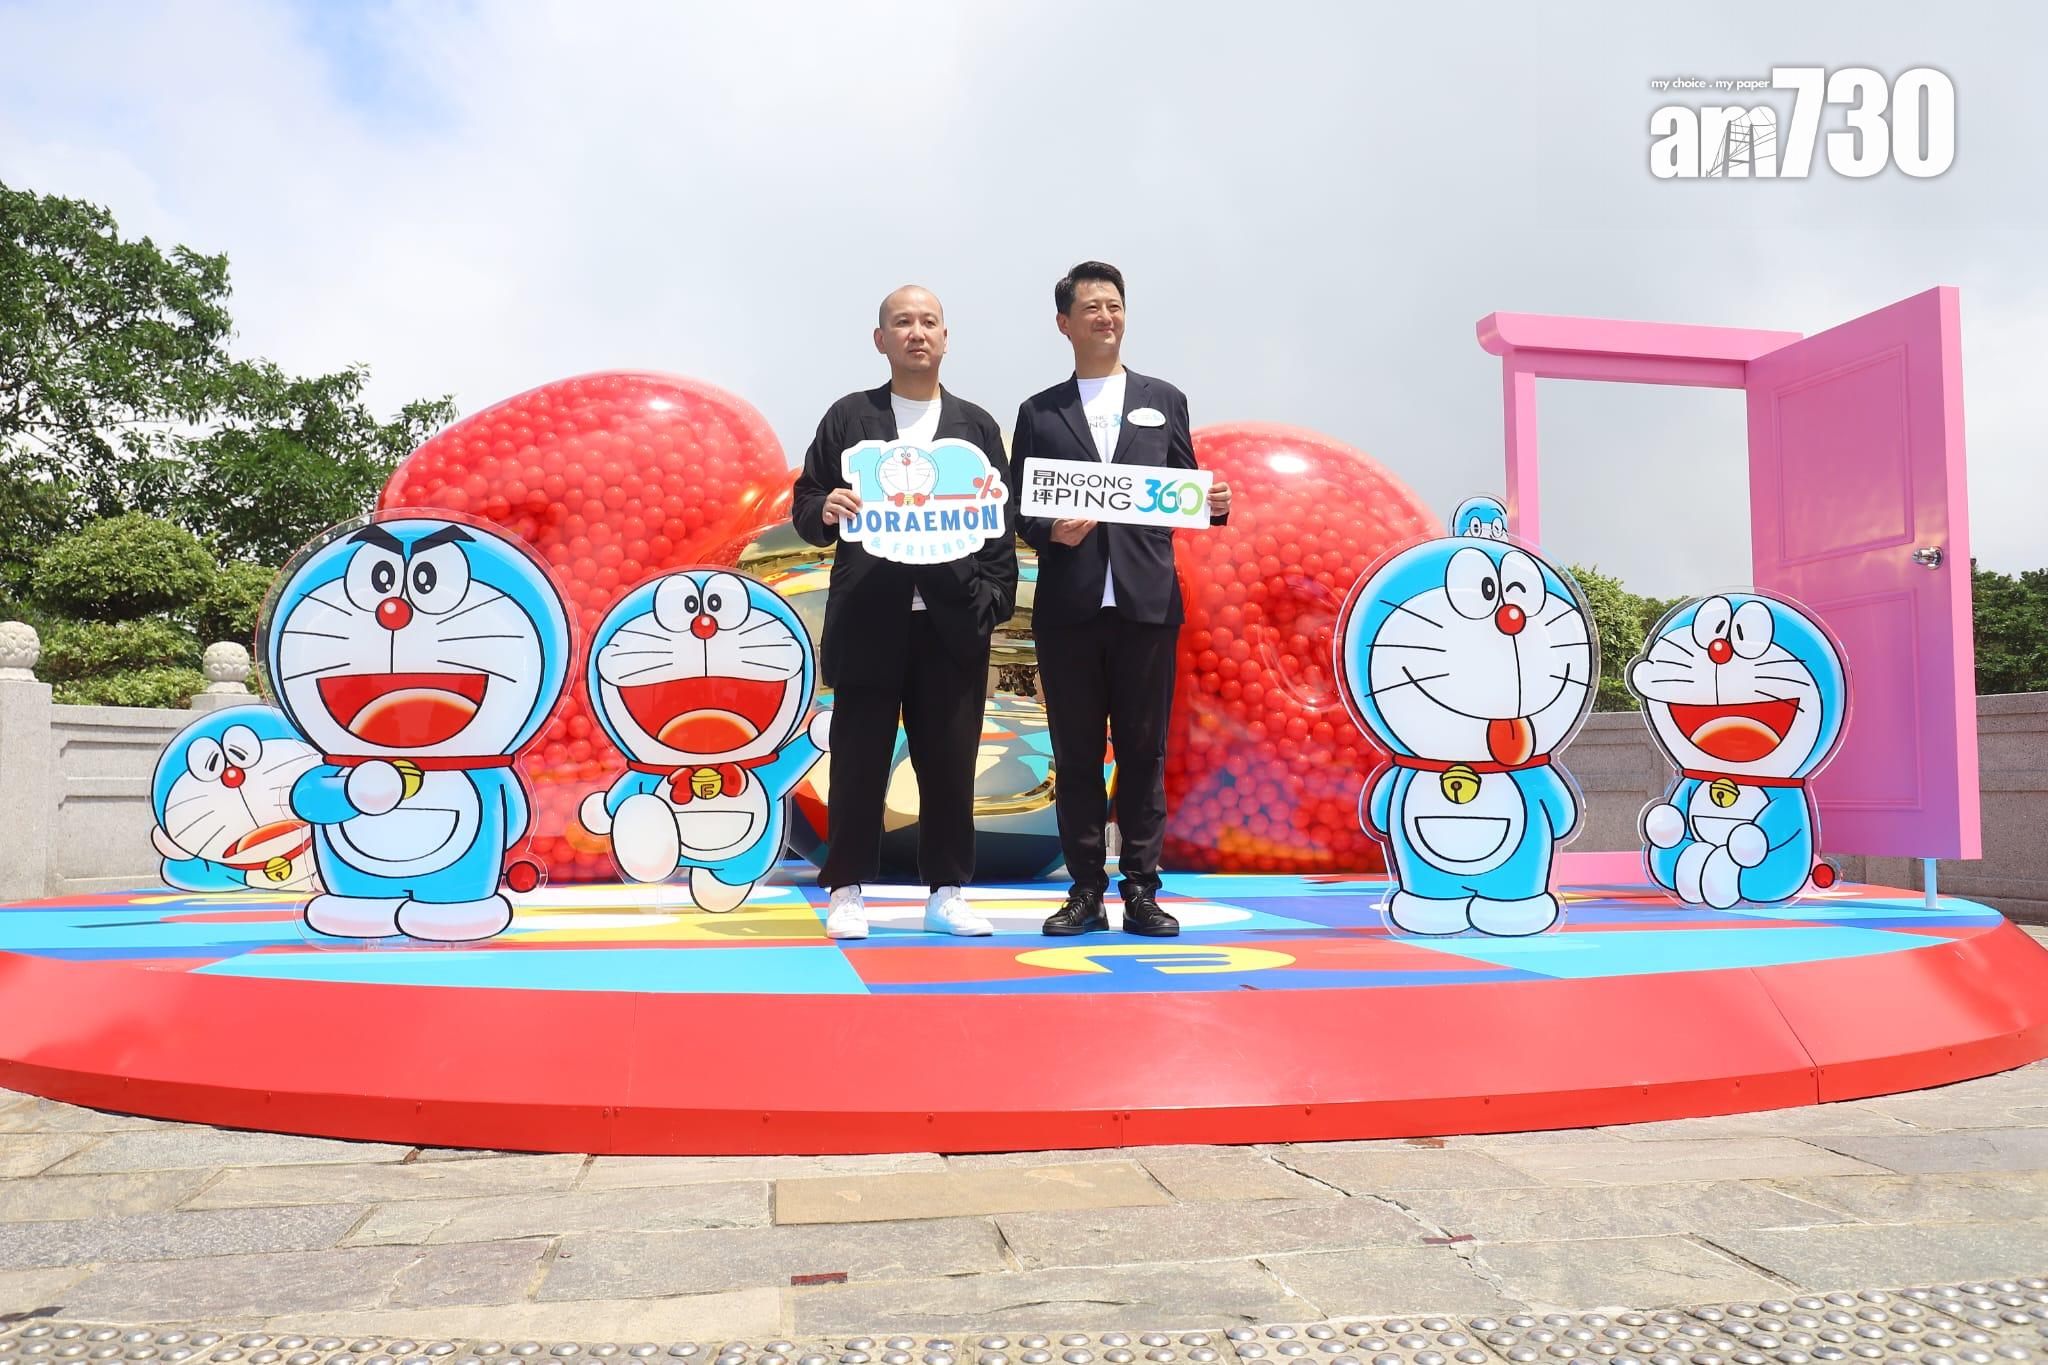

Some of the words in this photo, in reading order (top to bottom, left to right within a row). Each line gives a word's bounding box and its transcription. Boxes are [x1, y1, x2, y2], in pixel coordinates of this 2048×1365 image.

[1056, 472, 1133, 490] NGONG
[1055, 488, 1132, 511] PING
[1134, 478, 1204, 516] 360
[847, 504, 998, 534] DORAEMON
[893, 534, 978, 557] FRIENDS
